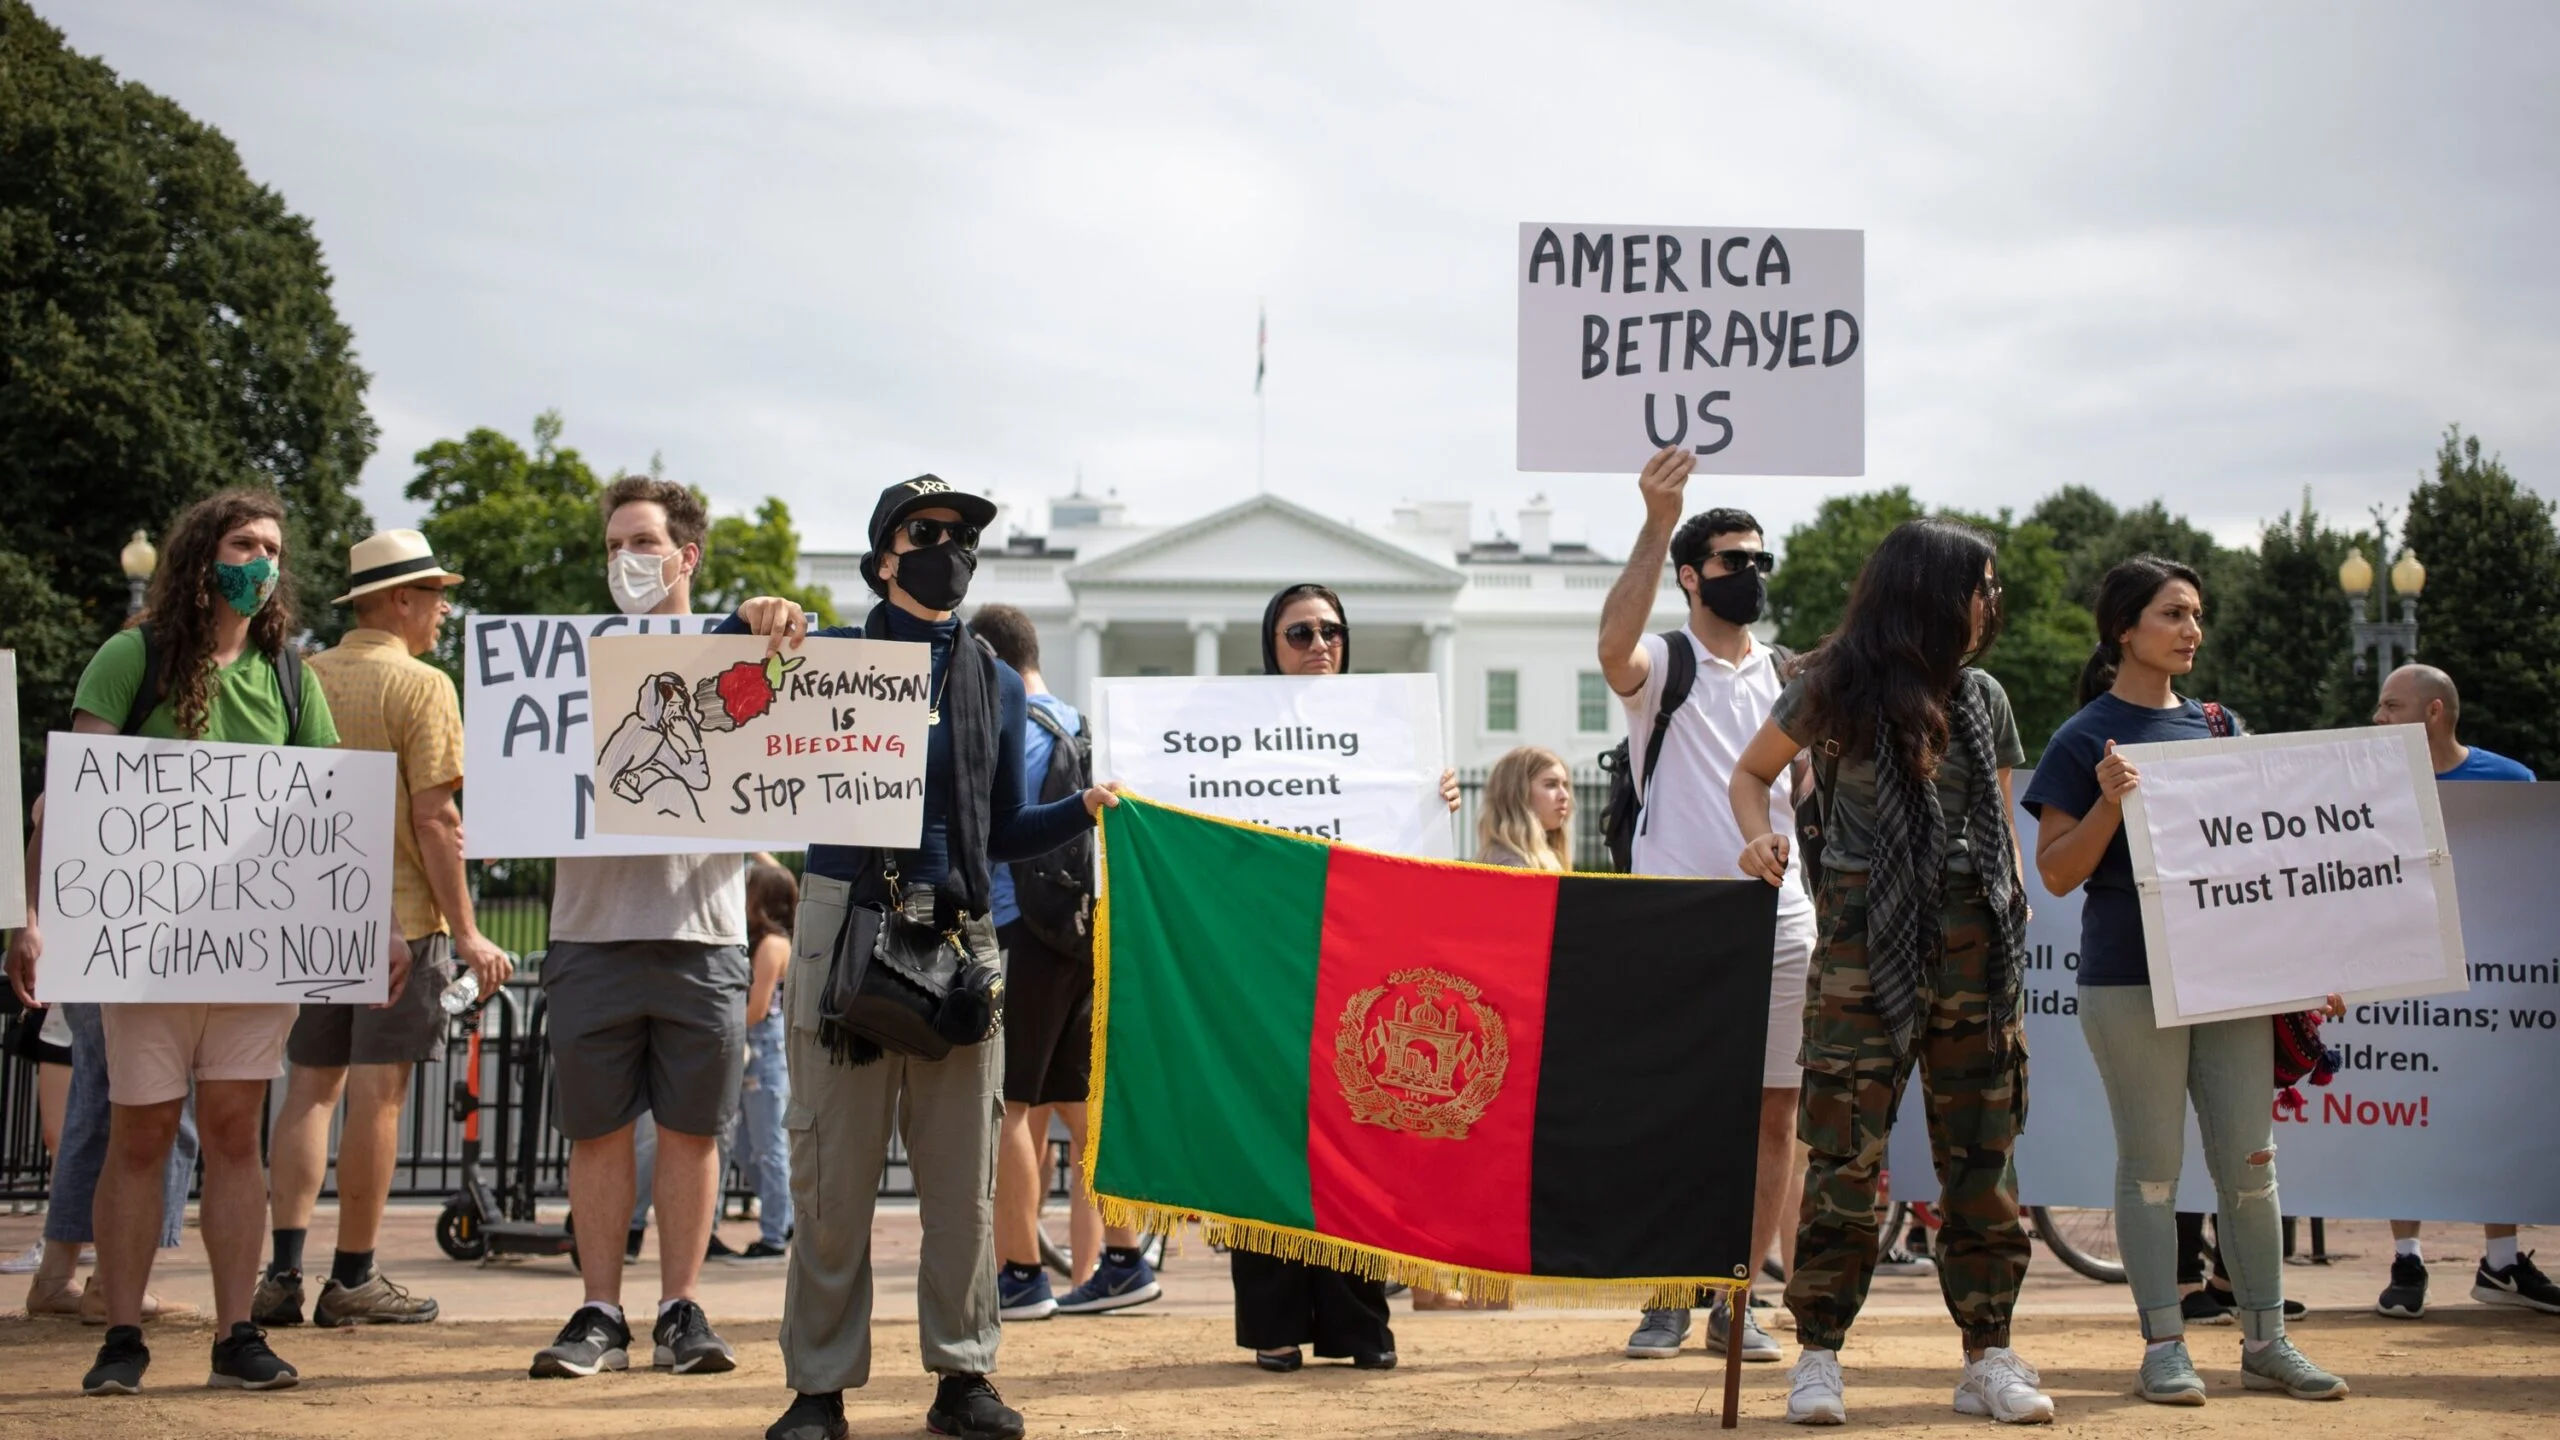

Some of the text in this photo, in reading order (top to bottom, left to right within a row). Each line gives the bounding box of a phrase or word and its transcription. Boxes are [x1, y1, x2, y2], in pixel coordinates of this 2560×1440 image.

[1528, 227, 1791, 293] AMERICA
[1582, 309, 1860, 380] BETRAYED
[1645, 390, 1734, 455] US
[790, 665, 931, 702] AFGANISTAN
[503, 691, 588, 757] AF
[832, 707, 856, 732] IS
[1163, 725, 1359, 759] Stop killing
[75, 747, 335, 807] AMERICA:
[817, 771, 924, 805] Taliban
[1189, 772, 1342, 799] innocent
[98, 801, 368, 859] OPEN YOUR
[2199, 802, 2375, 848] We Do Not
[55, 858, 372, 919] BORDERS TO
[2189, 855, 2404, 910] Trust Taliban!
[84, 920, 377, 982] AFGHANS NOW!
[2024, 944, 2560, 984] all o muni
[2024, 988, 2078, 1015] lida
[2355, 1000, 2499, 1032] civilians;
[2509, 1008, 2560, 1030] wo
[2272, 1093, 2429, 1128] ct Now!
